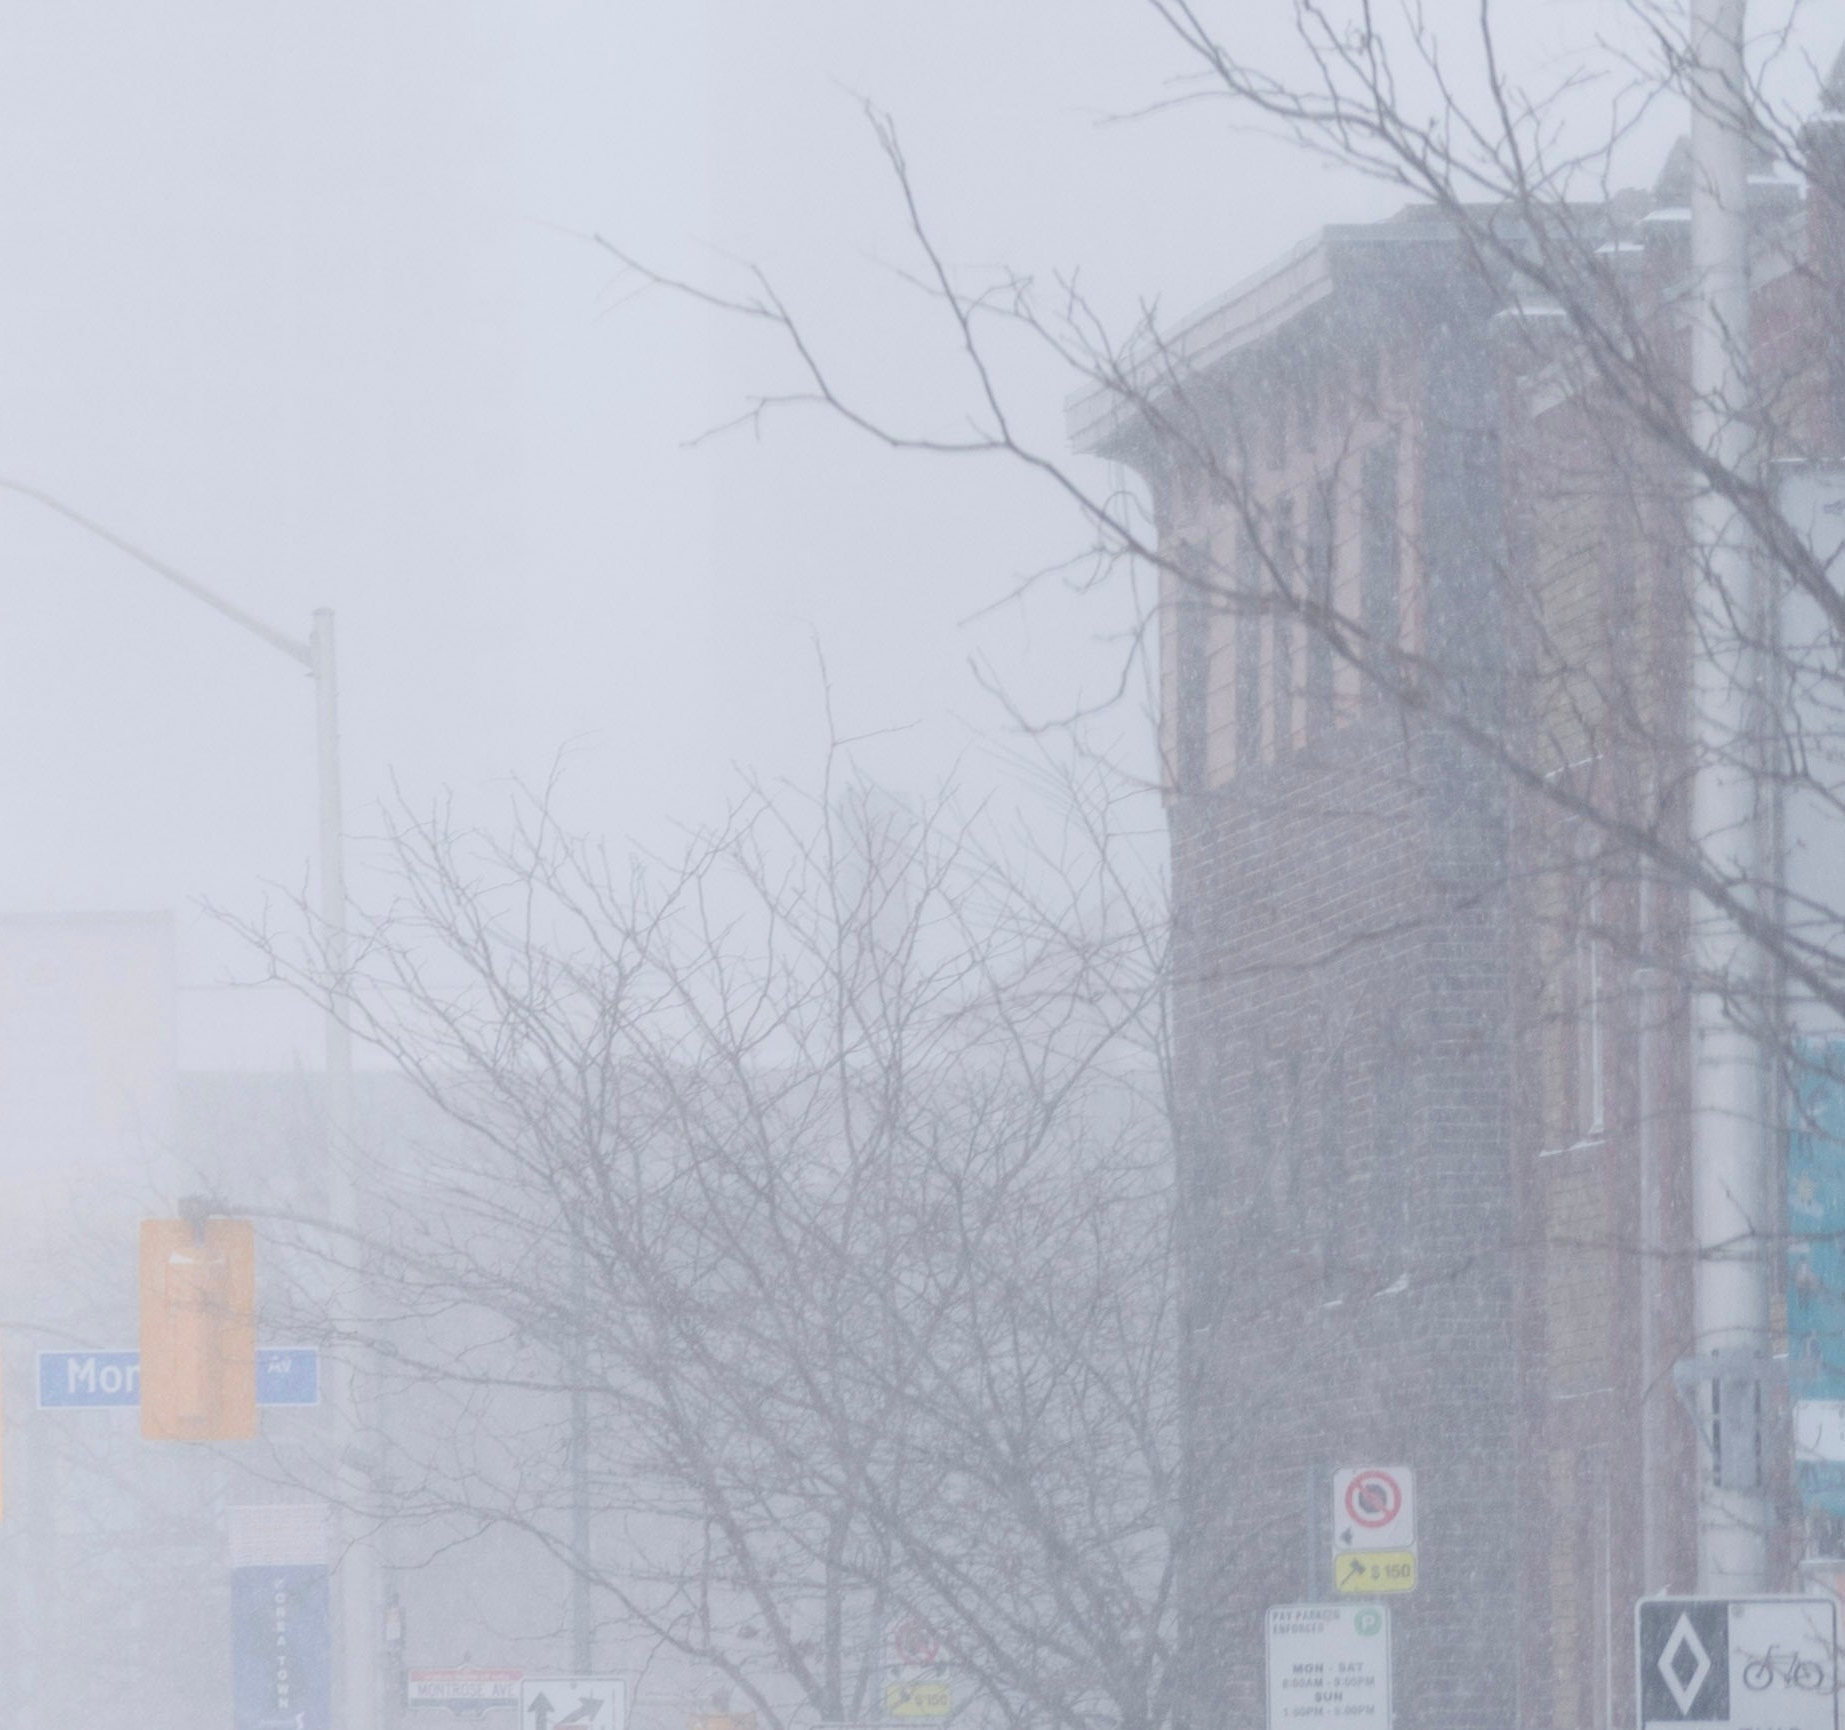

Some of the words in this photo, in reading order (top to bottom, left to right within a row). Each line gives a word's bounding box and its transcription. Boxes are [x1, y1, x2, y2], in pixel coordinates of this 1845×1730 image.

[1293, 1662, 1324, 1674] MON
[1338, 1661, 1364, 1673] SAT
[1315, 1691, 1343, 1702] SUN
